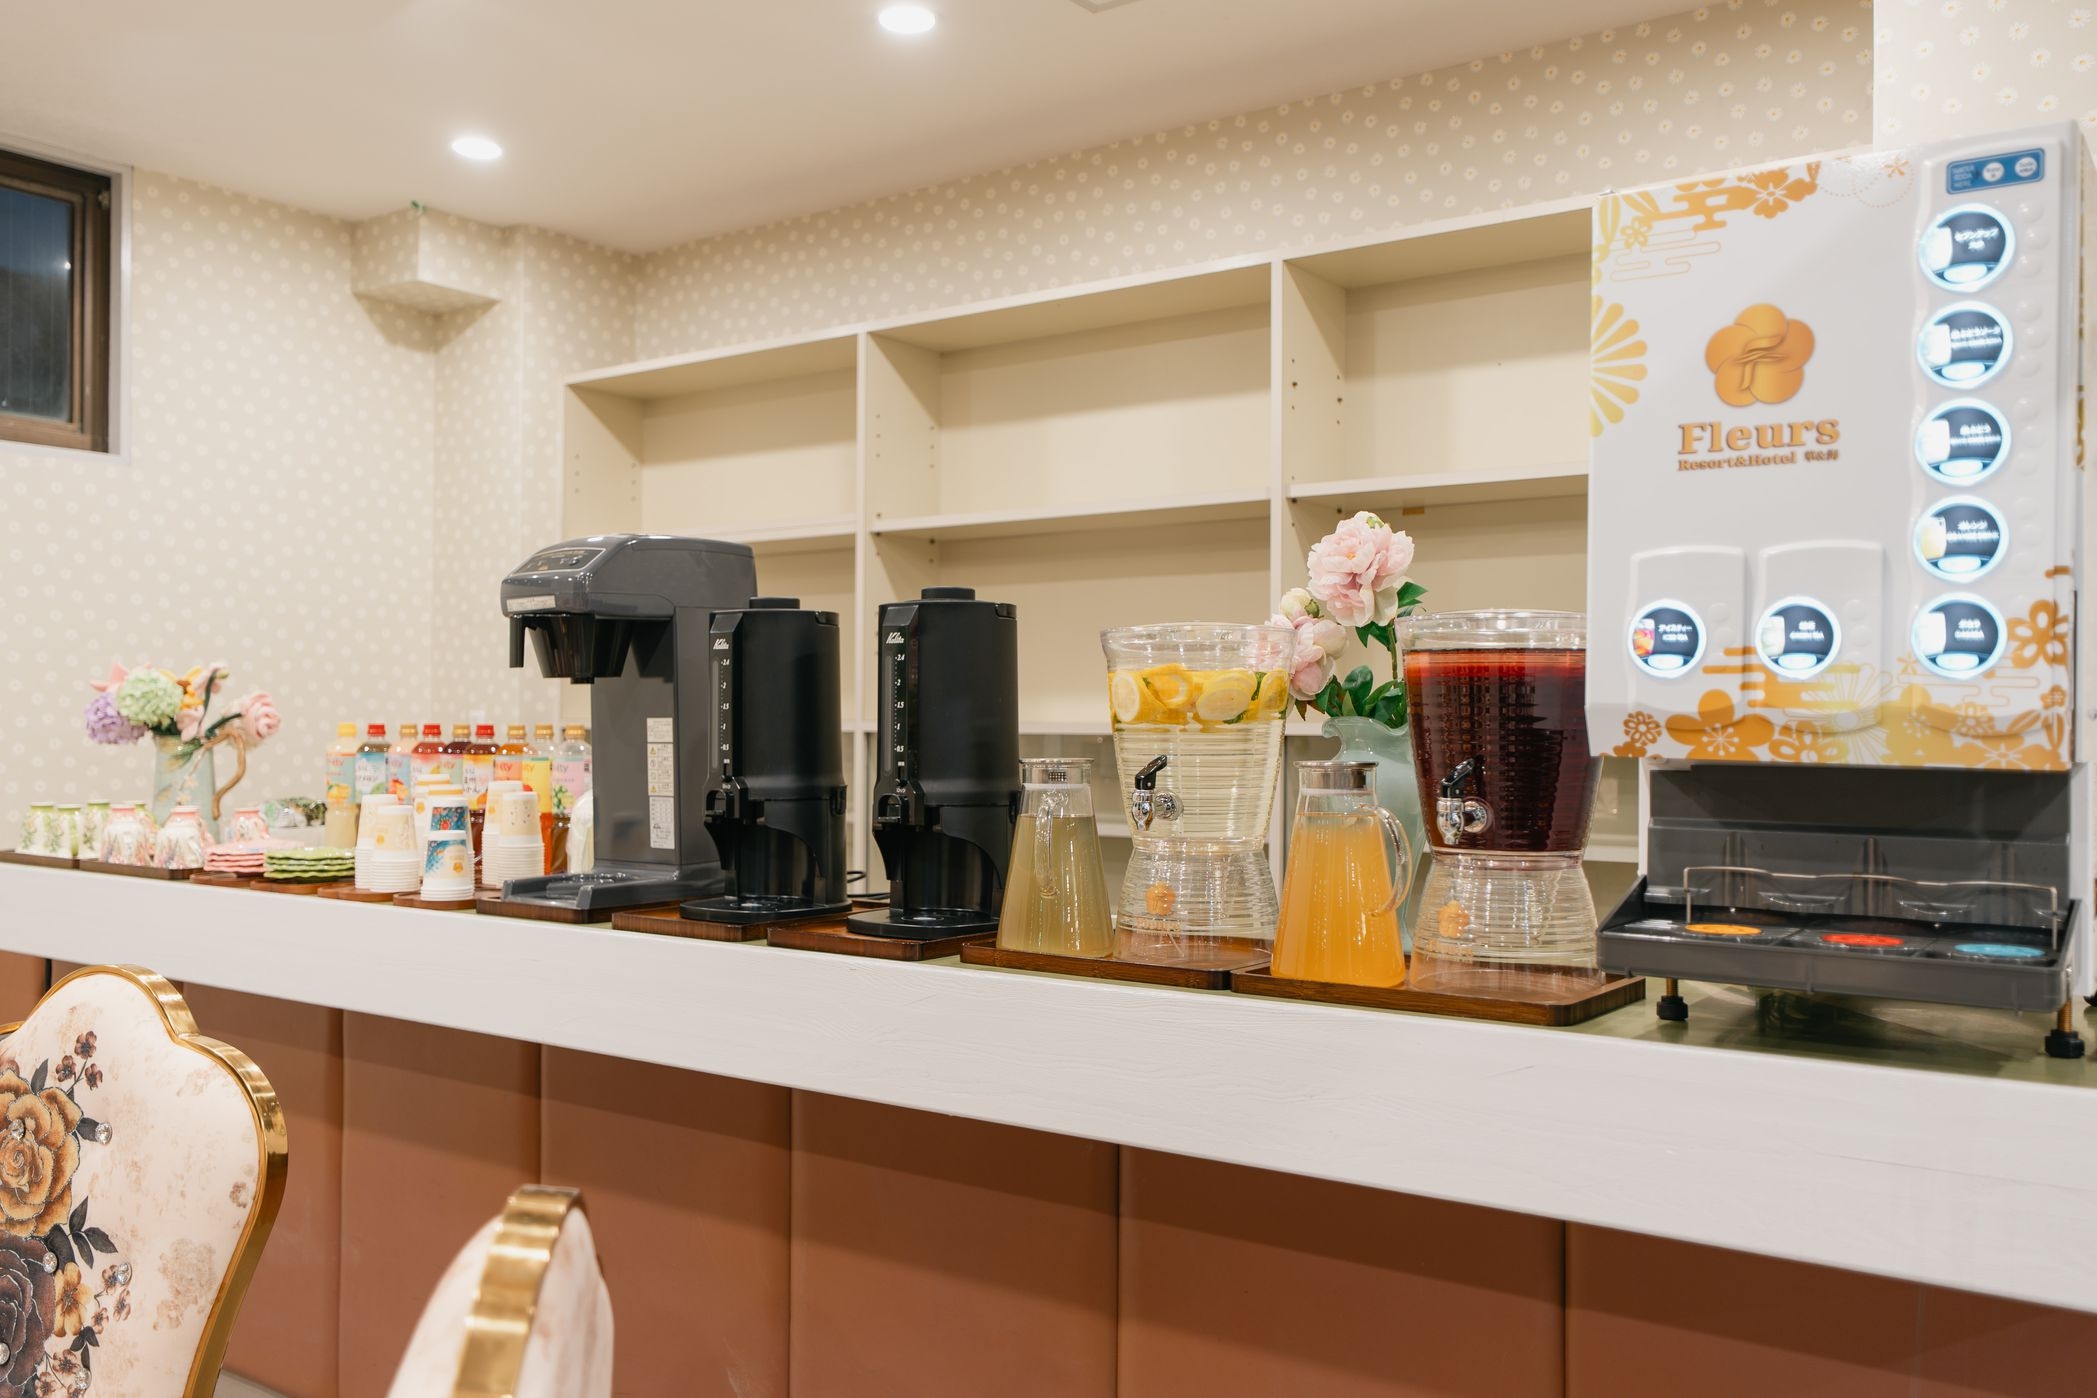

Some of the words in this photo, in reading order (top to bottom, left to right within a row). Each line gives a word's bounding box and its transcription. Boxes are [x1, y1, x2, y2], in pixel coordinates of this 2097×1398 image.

[1678, 418, 1840, 455] Fleurs
[1678, 451, 1798, 471] Resort&Hotel
[886, 632, 905, 644] Kalita
